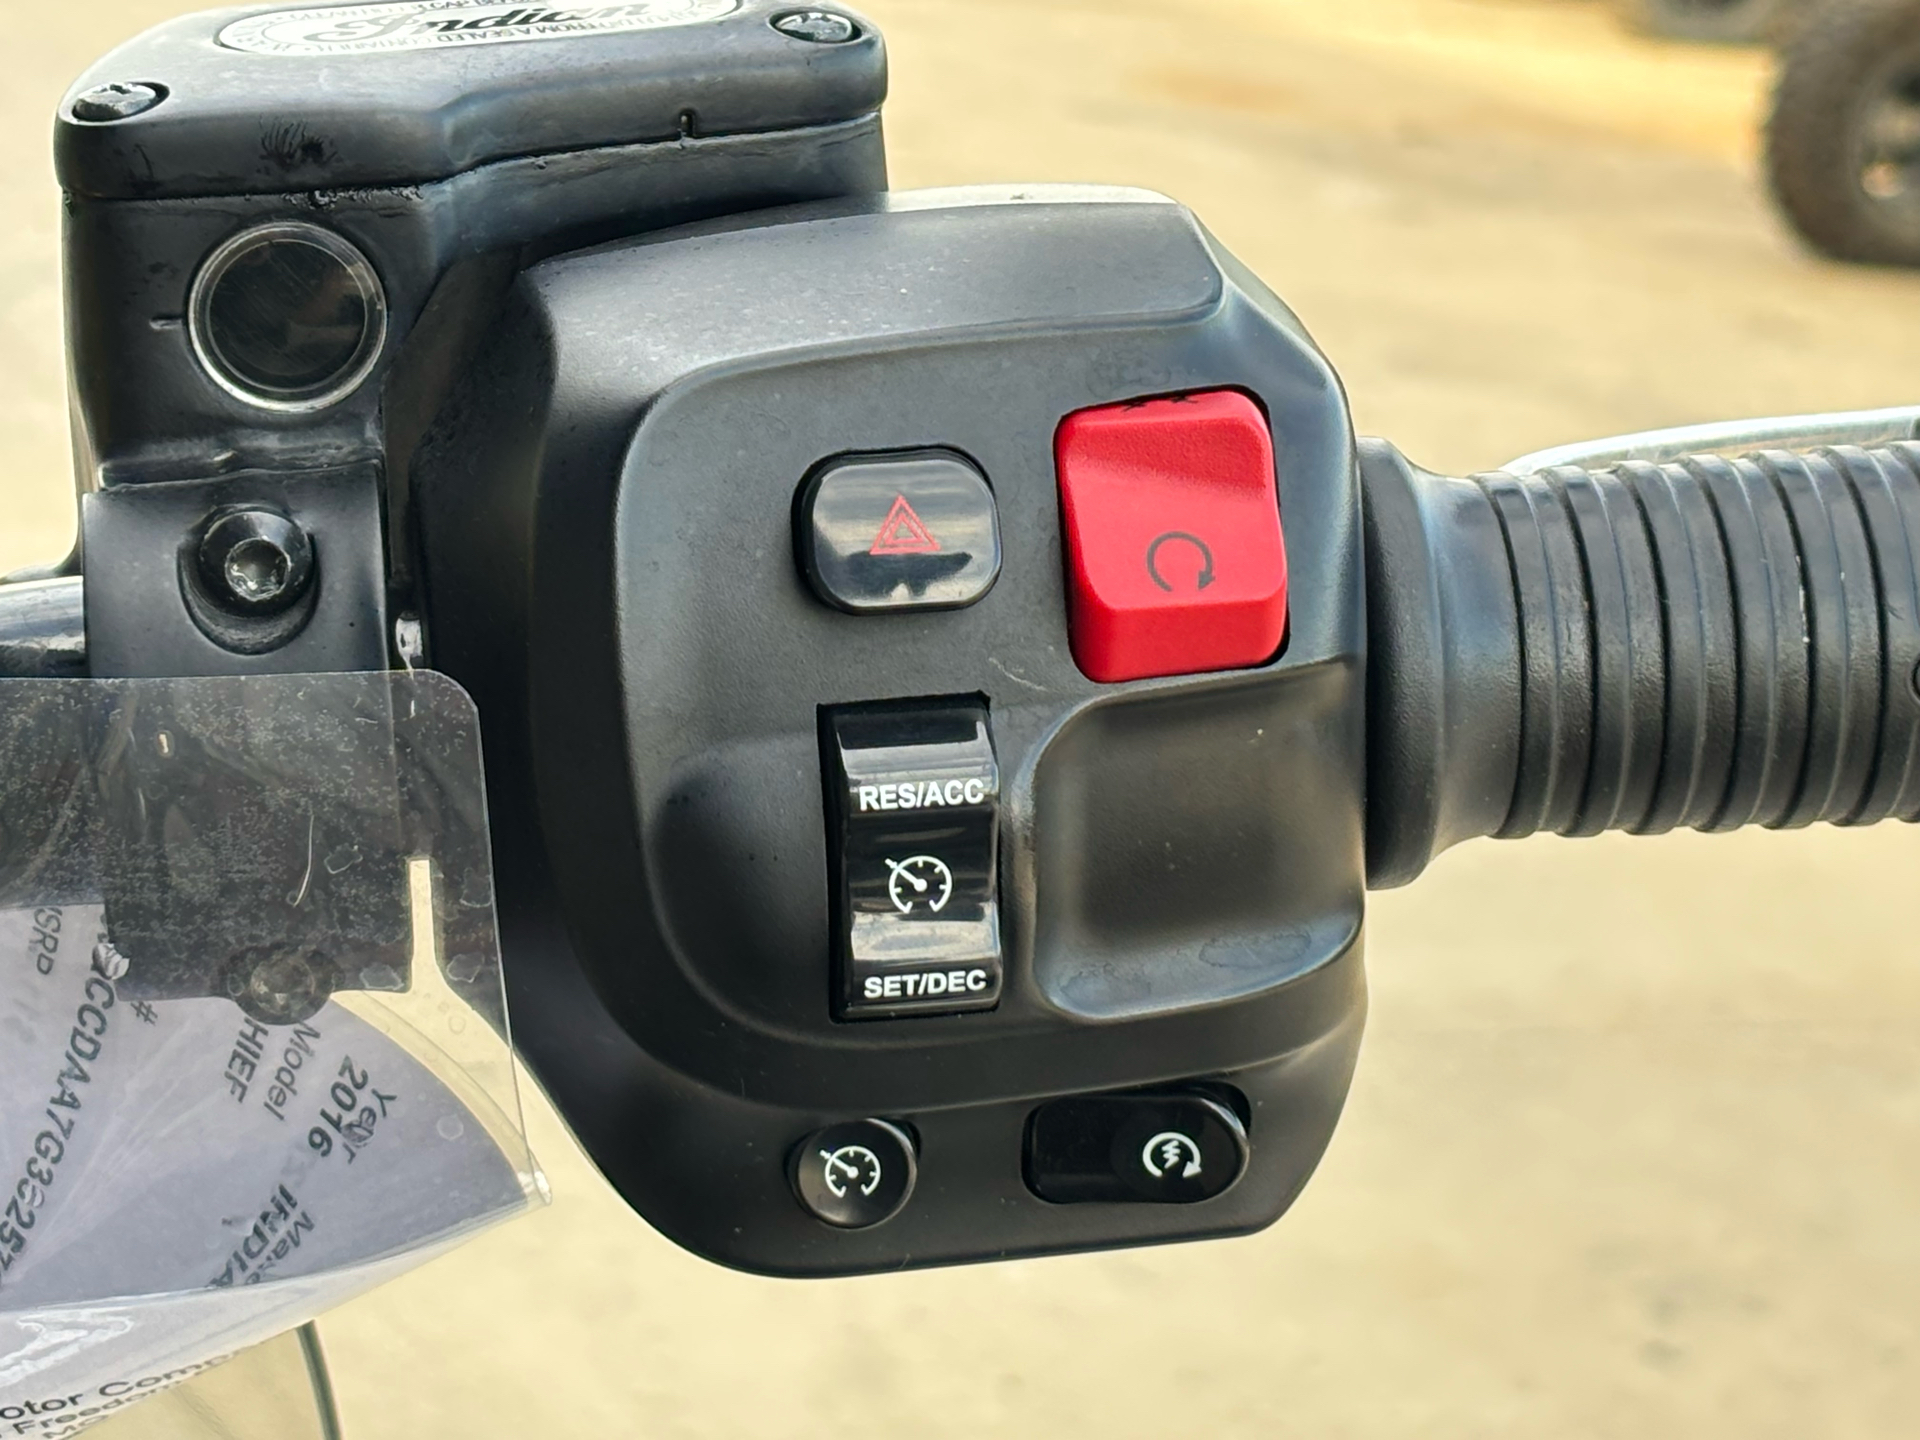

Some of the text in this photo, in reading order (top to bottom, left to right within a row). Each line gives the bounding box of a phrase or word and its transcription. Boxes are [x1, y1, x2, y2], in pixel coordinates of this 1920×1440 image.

[303, 6, 650, 43] Indian
[859, 778, 984, 811] RES/ACC
[29, 907, 62, 975] SRP
[864, 969, 986, 998] SET/DEC
[224, 1017, 269, 1103] HIEF
[264, 1020, 321, 1121] Model
[308, 1055, 369, 1157] 2016
[211, 1184, 297, 1287] INDIA
[0, 1349, 240, 1420] otor Comp
